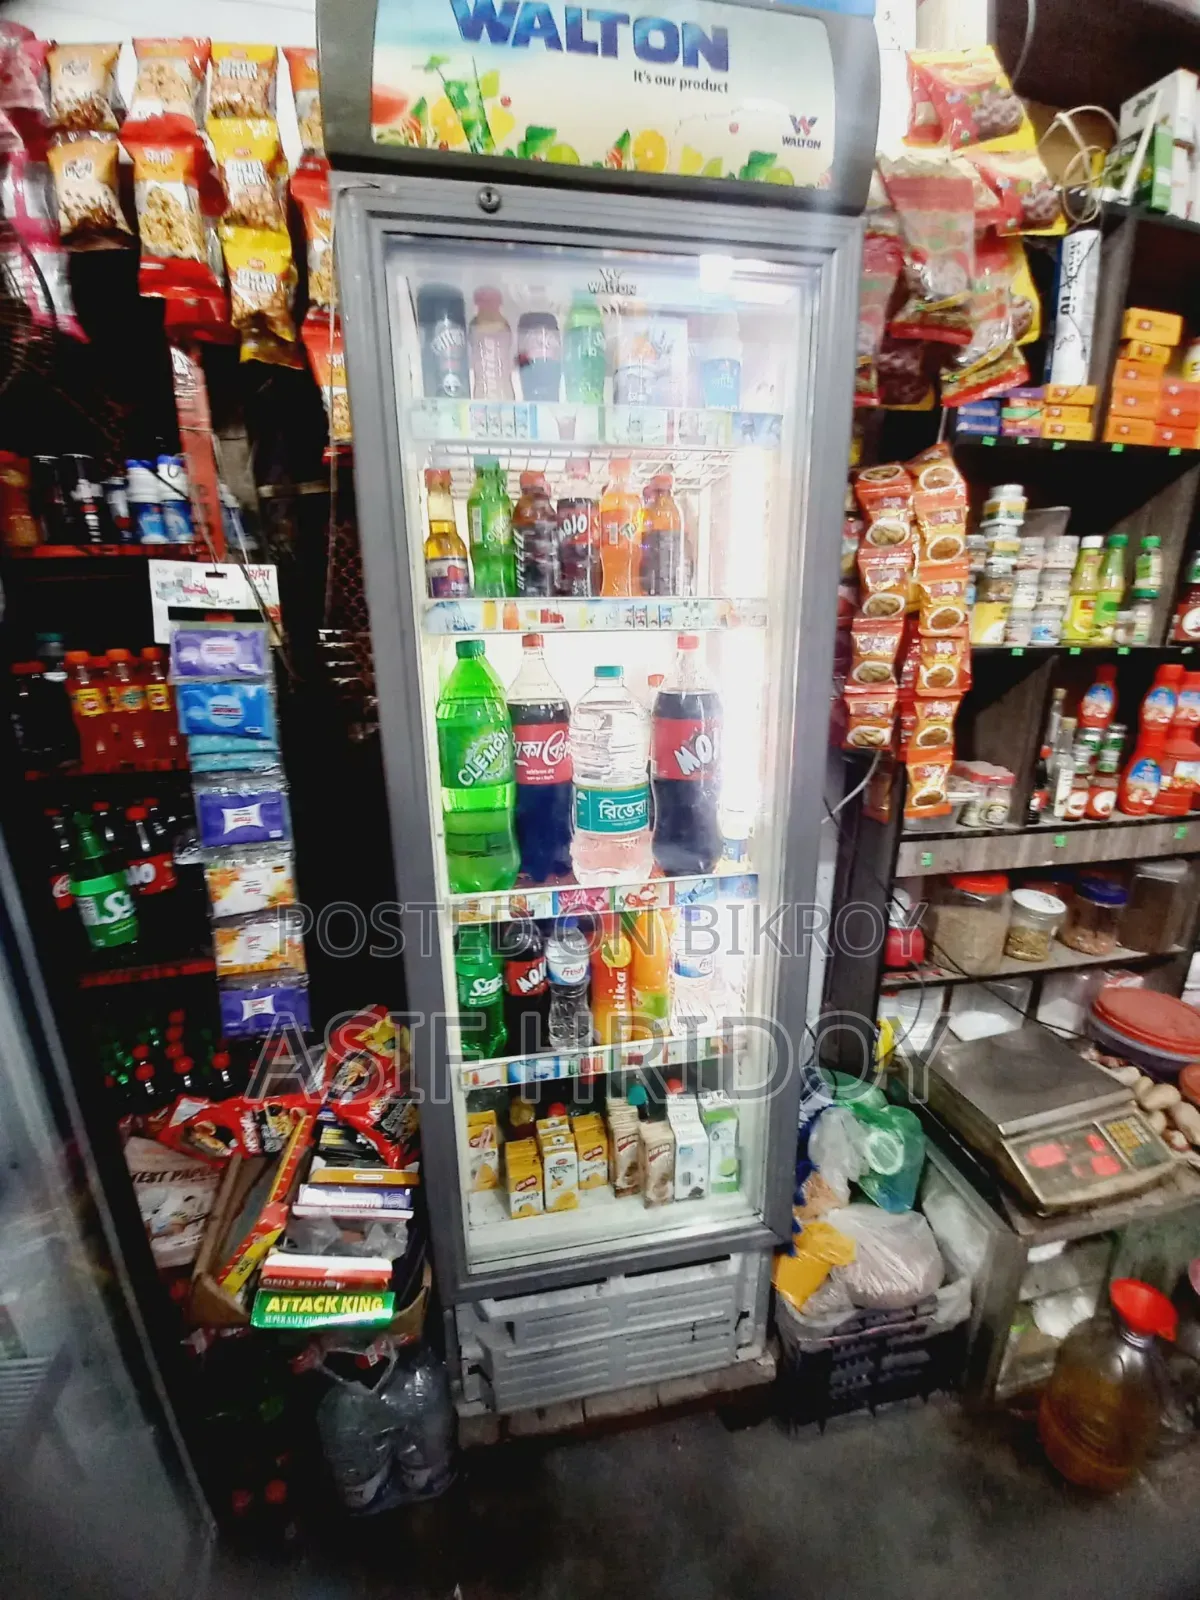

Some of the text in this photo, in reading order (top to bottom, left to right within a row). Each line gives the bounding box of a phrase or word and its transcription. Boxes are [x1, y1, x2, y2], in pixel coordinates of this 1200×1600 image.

[450, 0, 729, 72] WALTON
[633, 69, 729, 93] It's our product
[782, 135, 821, 150] WALTON
[587, 281, 637, 296] WALTON
[457, 726, 509, 787] CLEMON
[561, 966, 585, 978] Fresh
[266, 1295, 384, 1314] ATTACK KING
